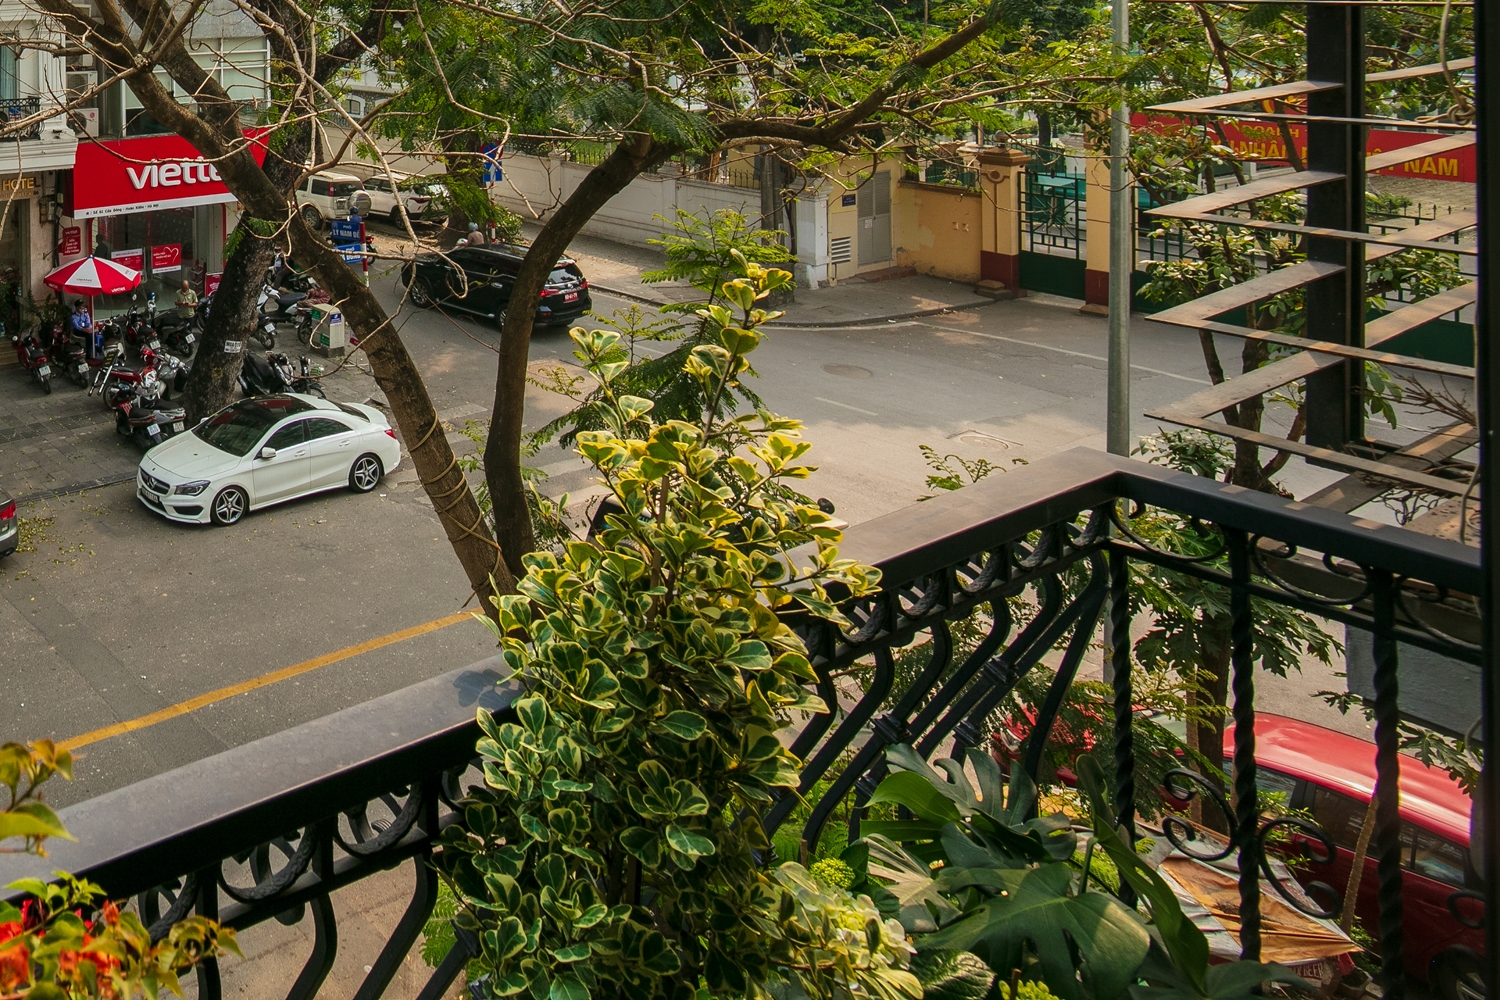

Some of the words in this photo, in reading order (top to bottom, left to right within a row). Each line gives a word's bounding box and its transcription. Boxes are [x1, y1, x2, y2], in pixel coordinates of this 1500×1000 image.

[1403, 156, 1459, 177] NAM
[2, 176, 41, 191] HOTEL
[1303, 962, 1324, 978] BEER
